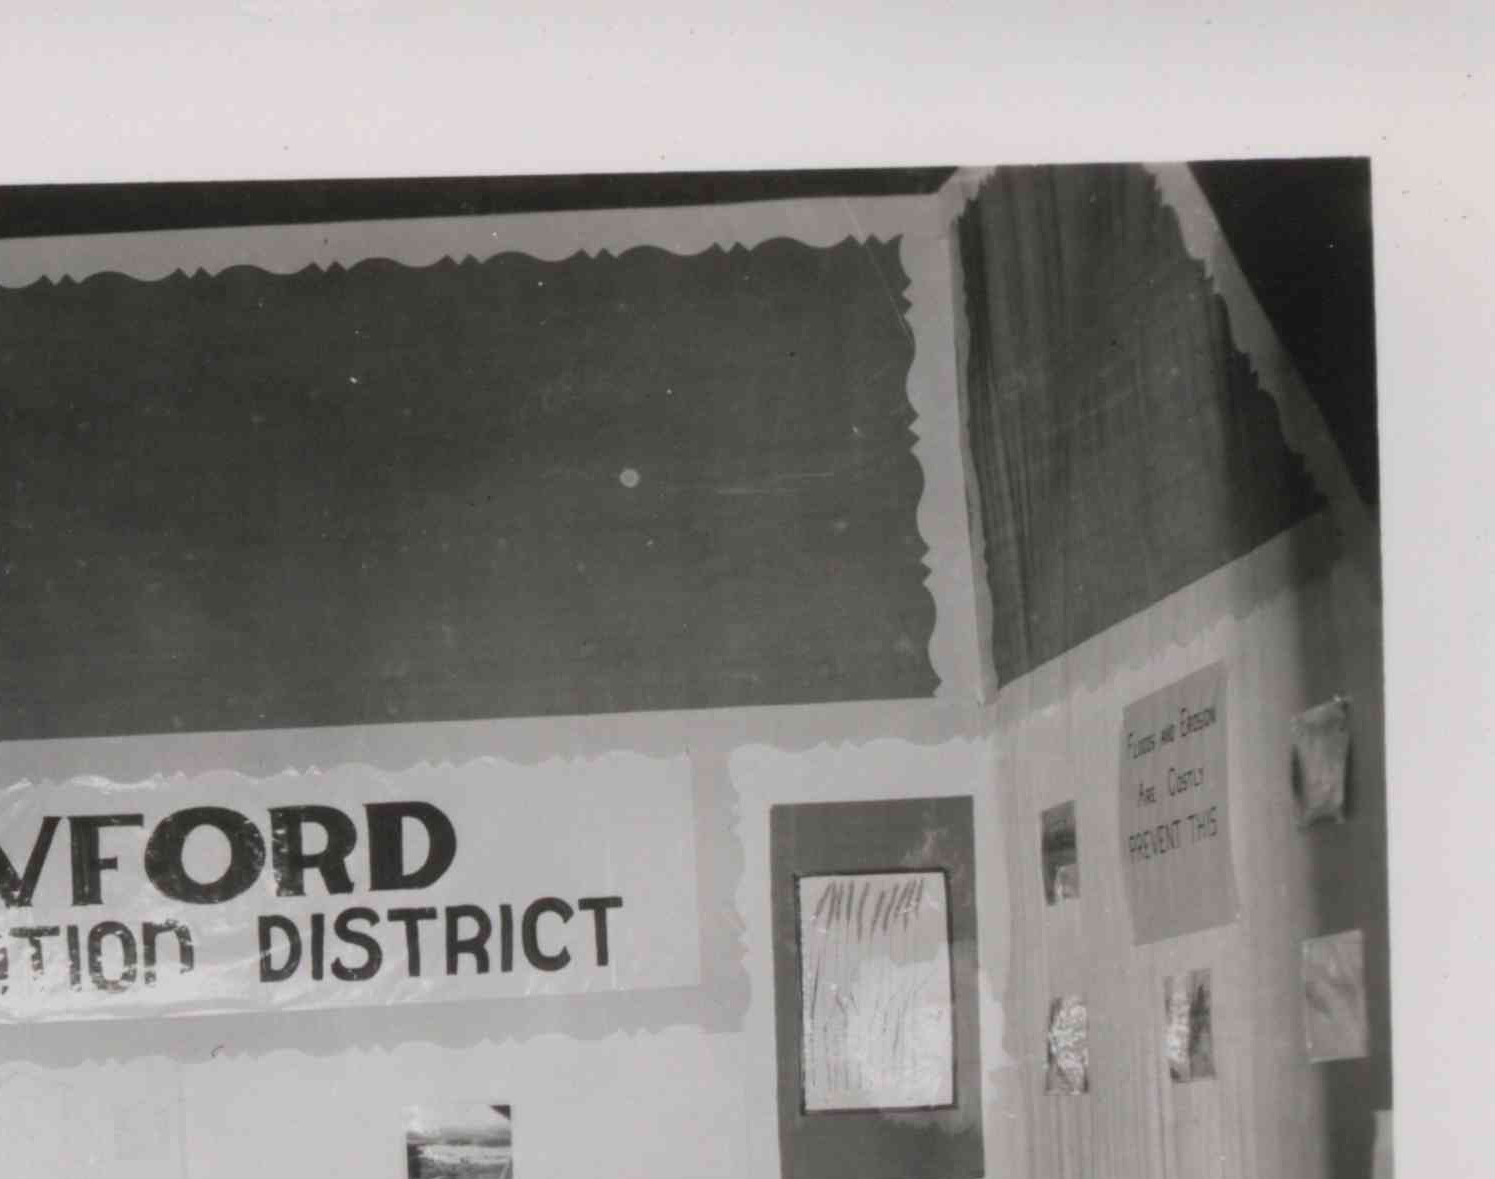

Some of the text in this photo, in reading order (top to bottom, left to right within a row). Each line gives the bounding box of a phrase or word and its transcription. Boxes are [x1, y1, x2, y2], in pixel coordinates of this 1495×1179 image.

[1128, 806, 1218, 864] PREVENT THIS
[258, 896, 624, 983] DISTRICT
